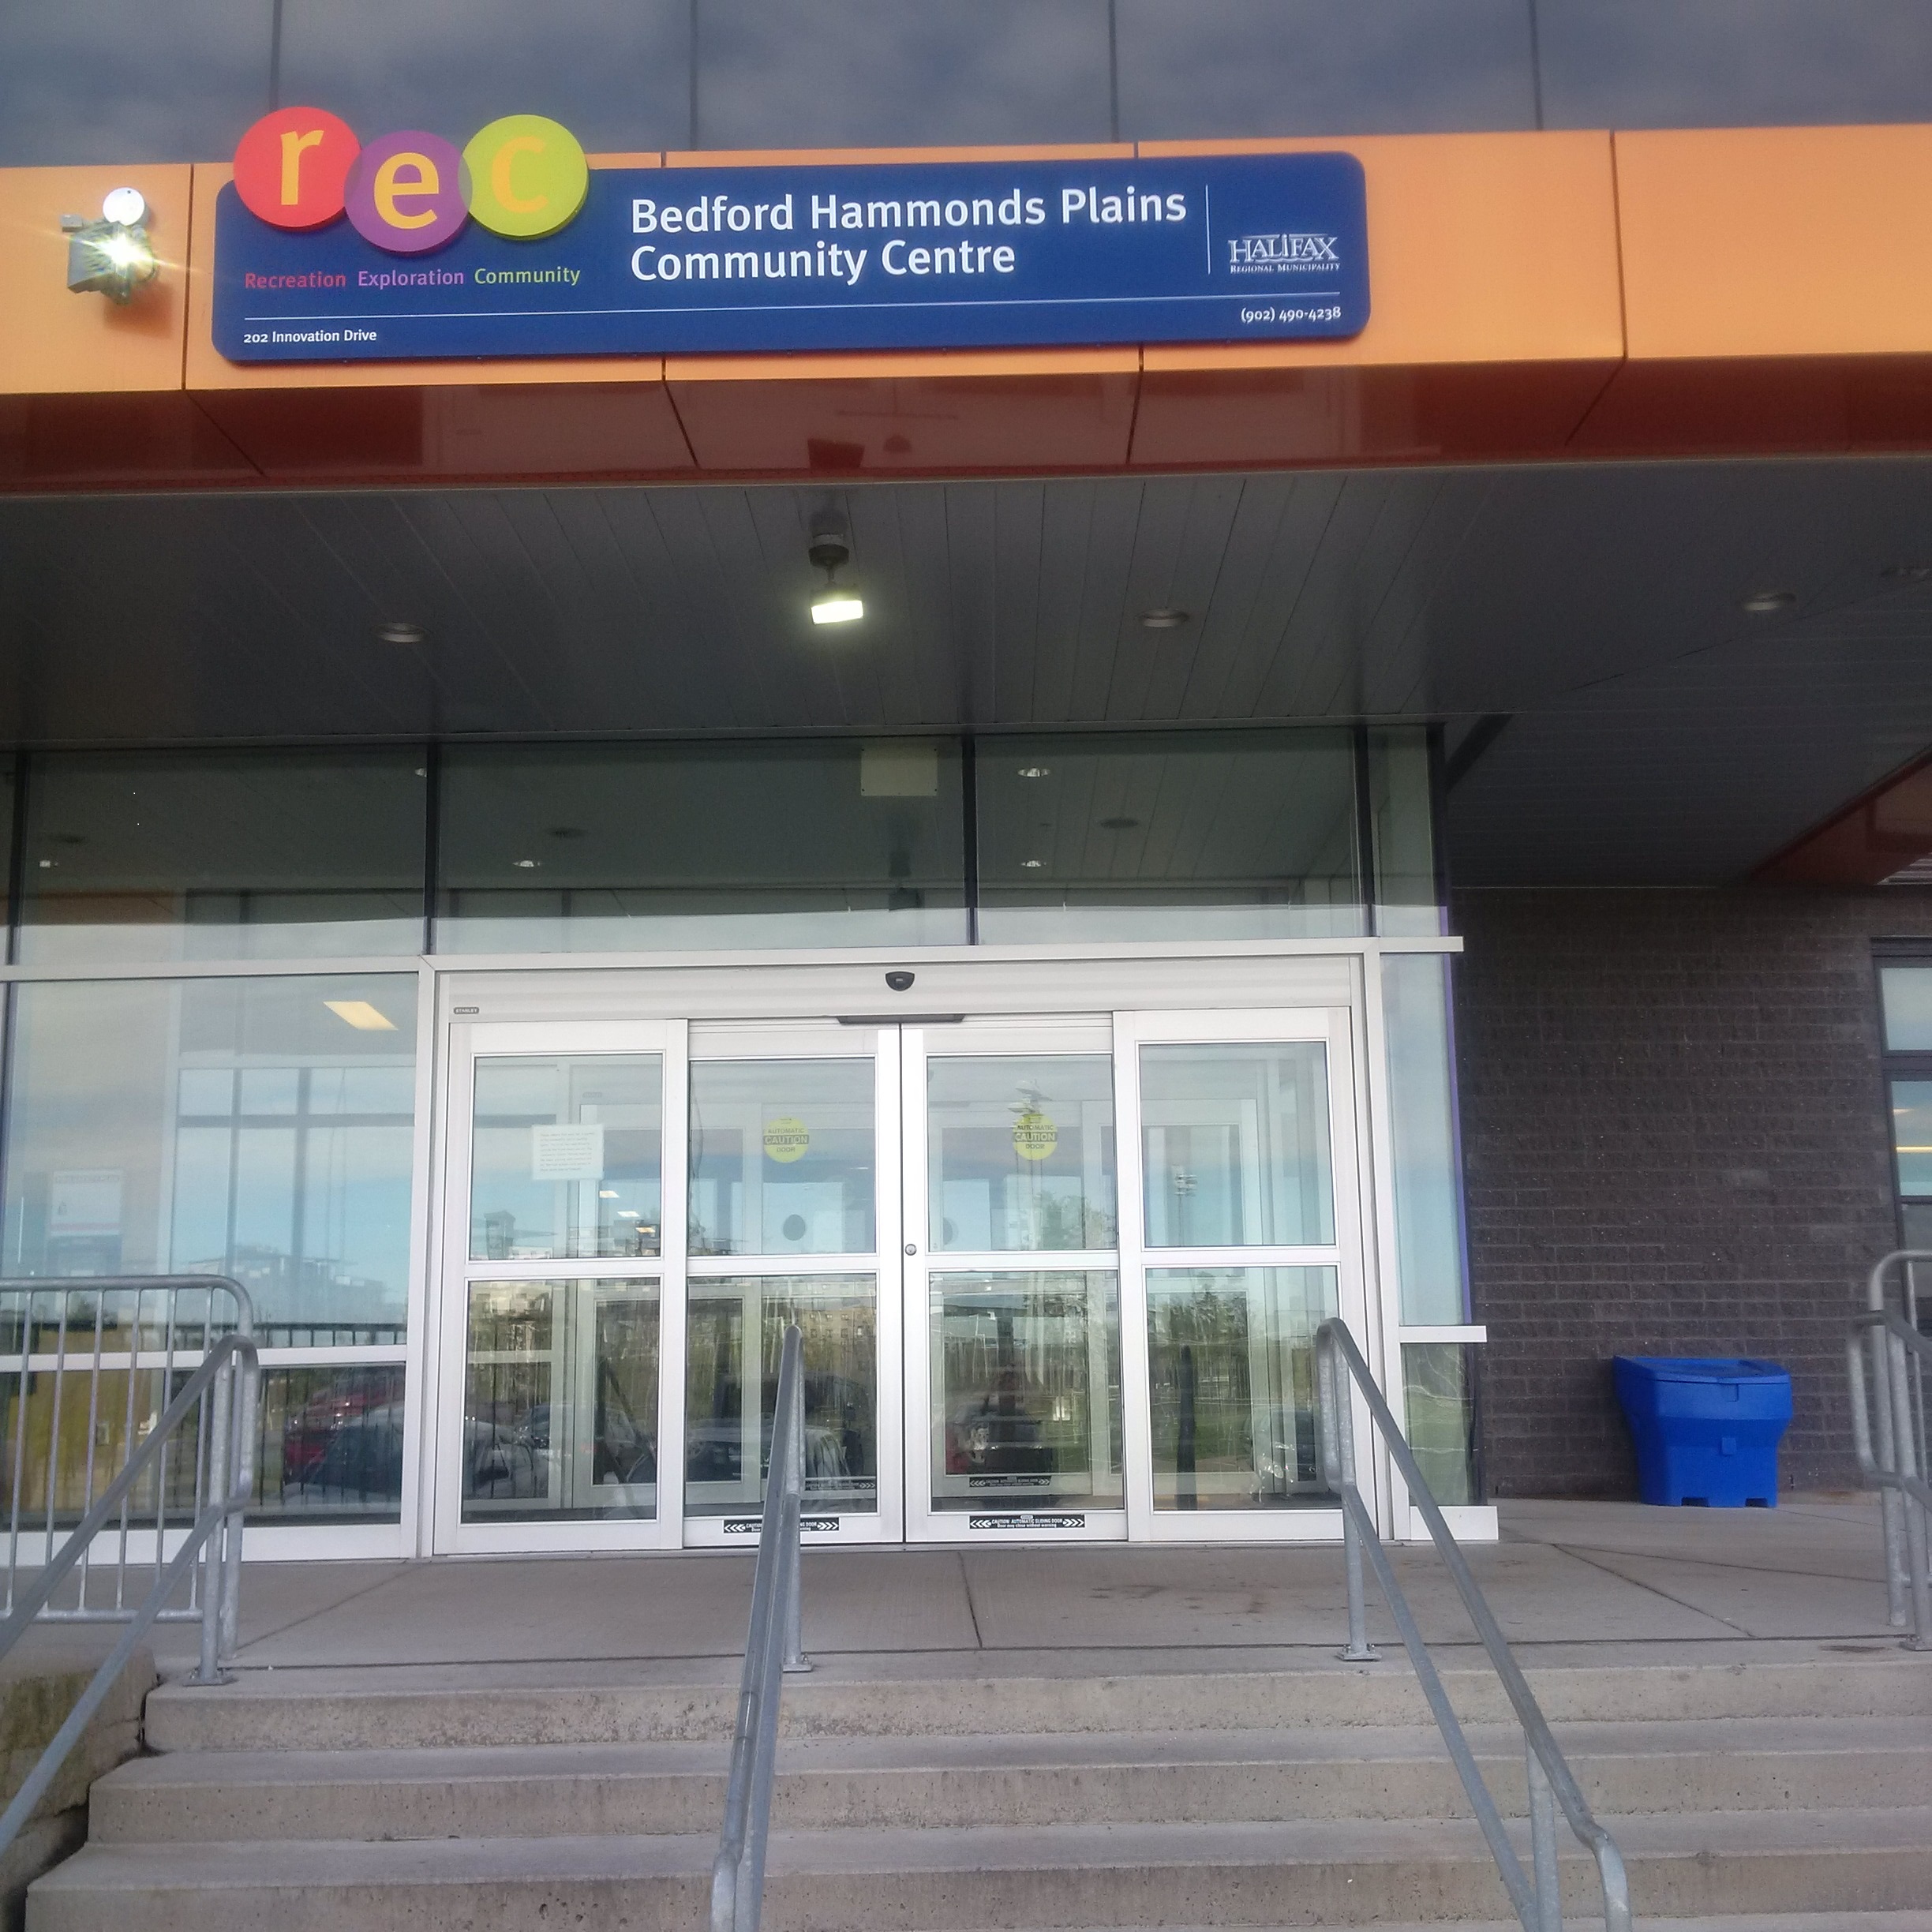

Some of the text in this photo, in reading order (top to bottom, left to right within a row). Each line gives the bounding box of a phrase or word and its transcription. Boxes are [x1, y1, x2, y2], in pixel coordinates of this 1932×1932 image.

[279, 129, 549, 230] rec
[631, 185, 1187, 234] Bedford Hammonds Plains
[1228, 234, 1339, 264] HALIFAX
[631, 238, 1017, 286] Community Centre
[245, 266, 581, 290] Recreation Exploration Community
[1241, 305, 1342, 324] (902) 490-4238
[243, 328, 378, 344] 202 Innovation Drive
[765, 1136, 808, 1144] CAUTION
[1015, 1133, 1055, 1142] CAUTION
